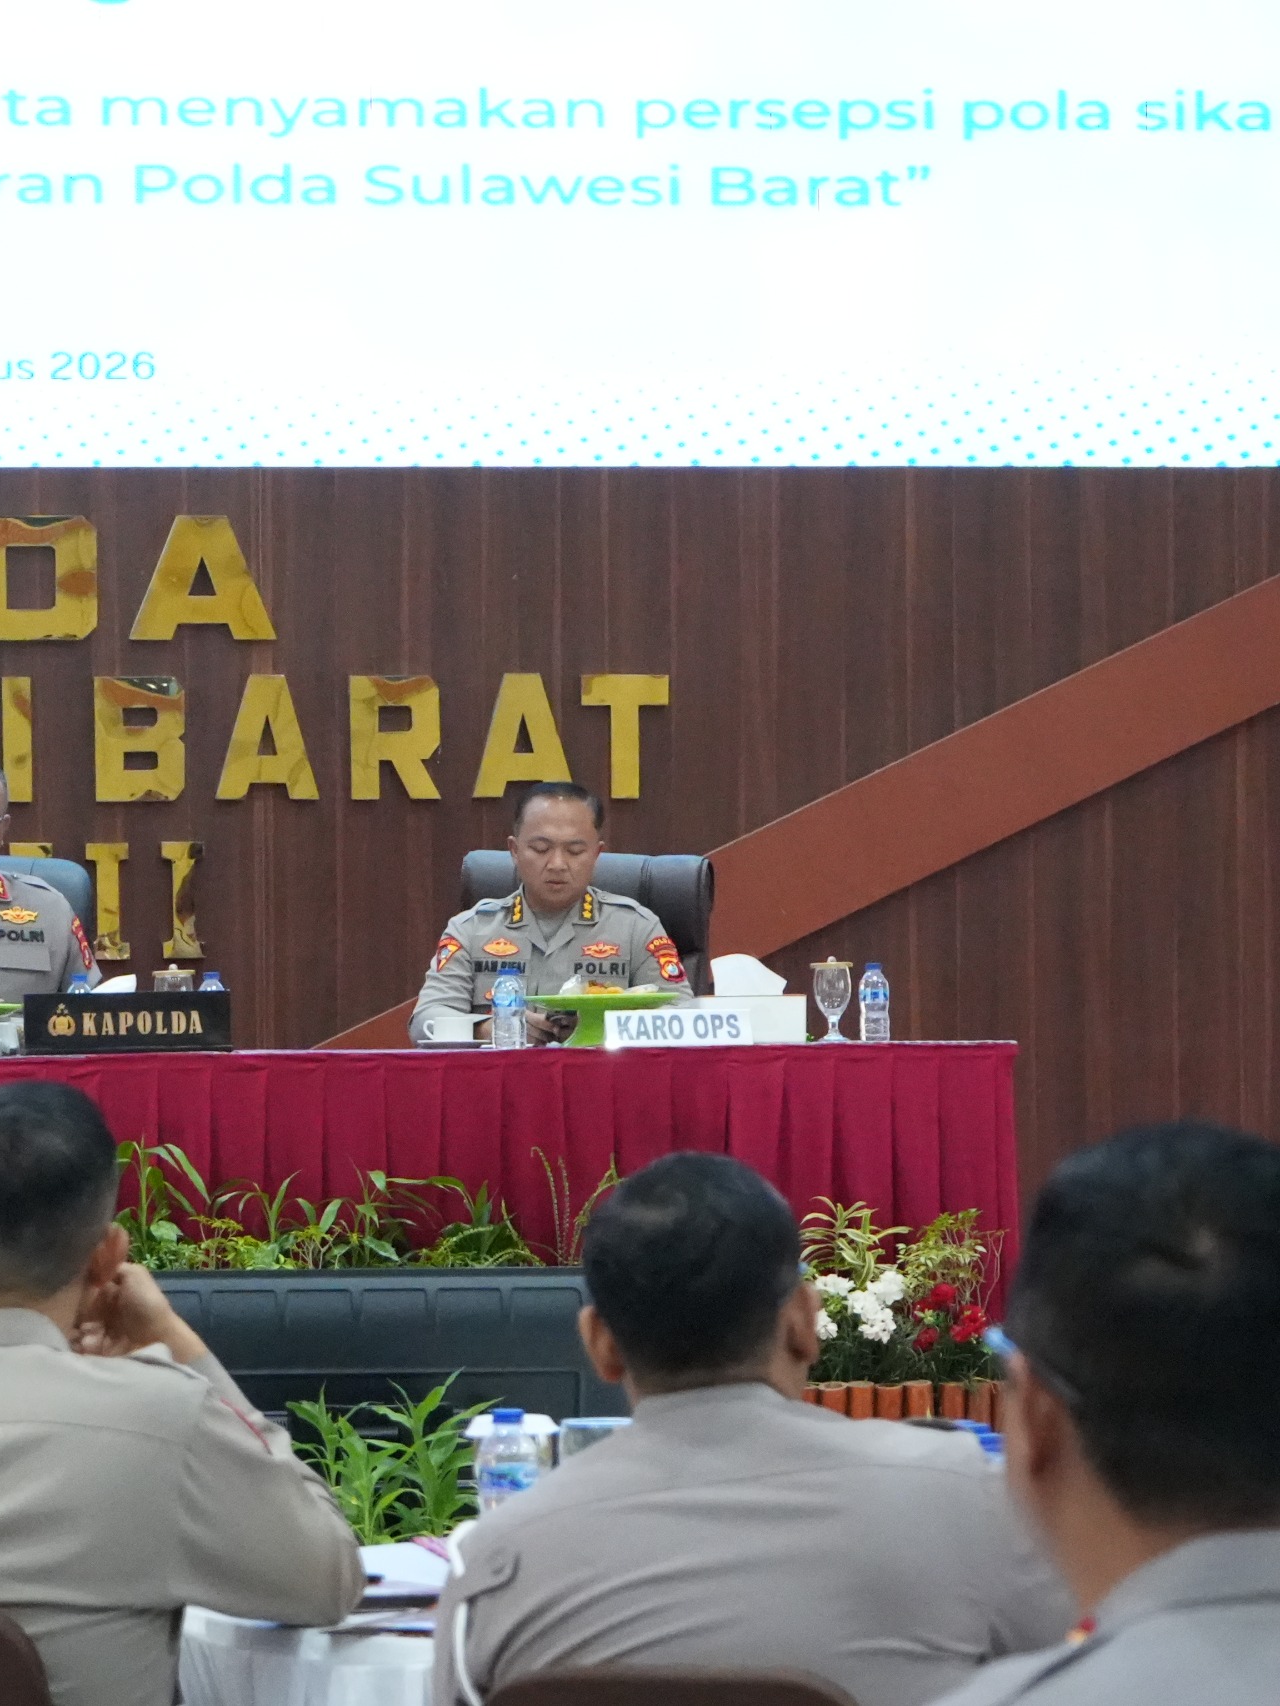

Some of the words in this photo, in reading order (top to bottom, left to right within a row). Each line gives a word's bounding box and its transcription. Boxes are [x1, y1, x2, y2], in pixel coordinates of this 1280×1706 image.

[102, 87, 605, 138] menyamakan
[636, 88, 936, 141] persepsi
[962, 89, 1111, 142] pola
[135, 163, 337, 206] Polda
[365, 163, 681, 207] Sulawesi
[50, 351, 157, 382] 2026
[93, 672, 670, 803] BARAT
[574, 962, 626, 976] POLRI
[82, 1010, 203, 1036] KAPOLDA
[616, 1014, 685, 1041] KARO
[693, 1014, 741, 1039] OPS
